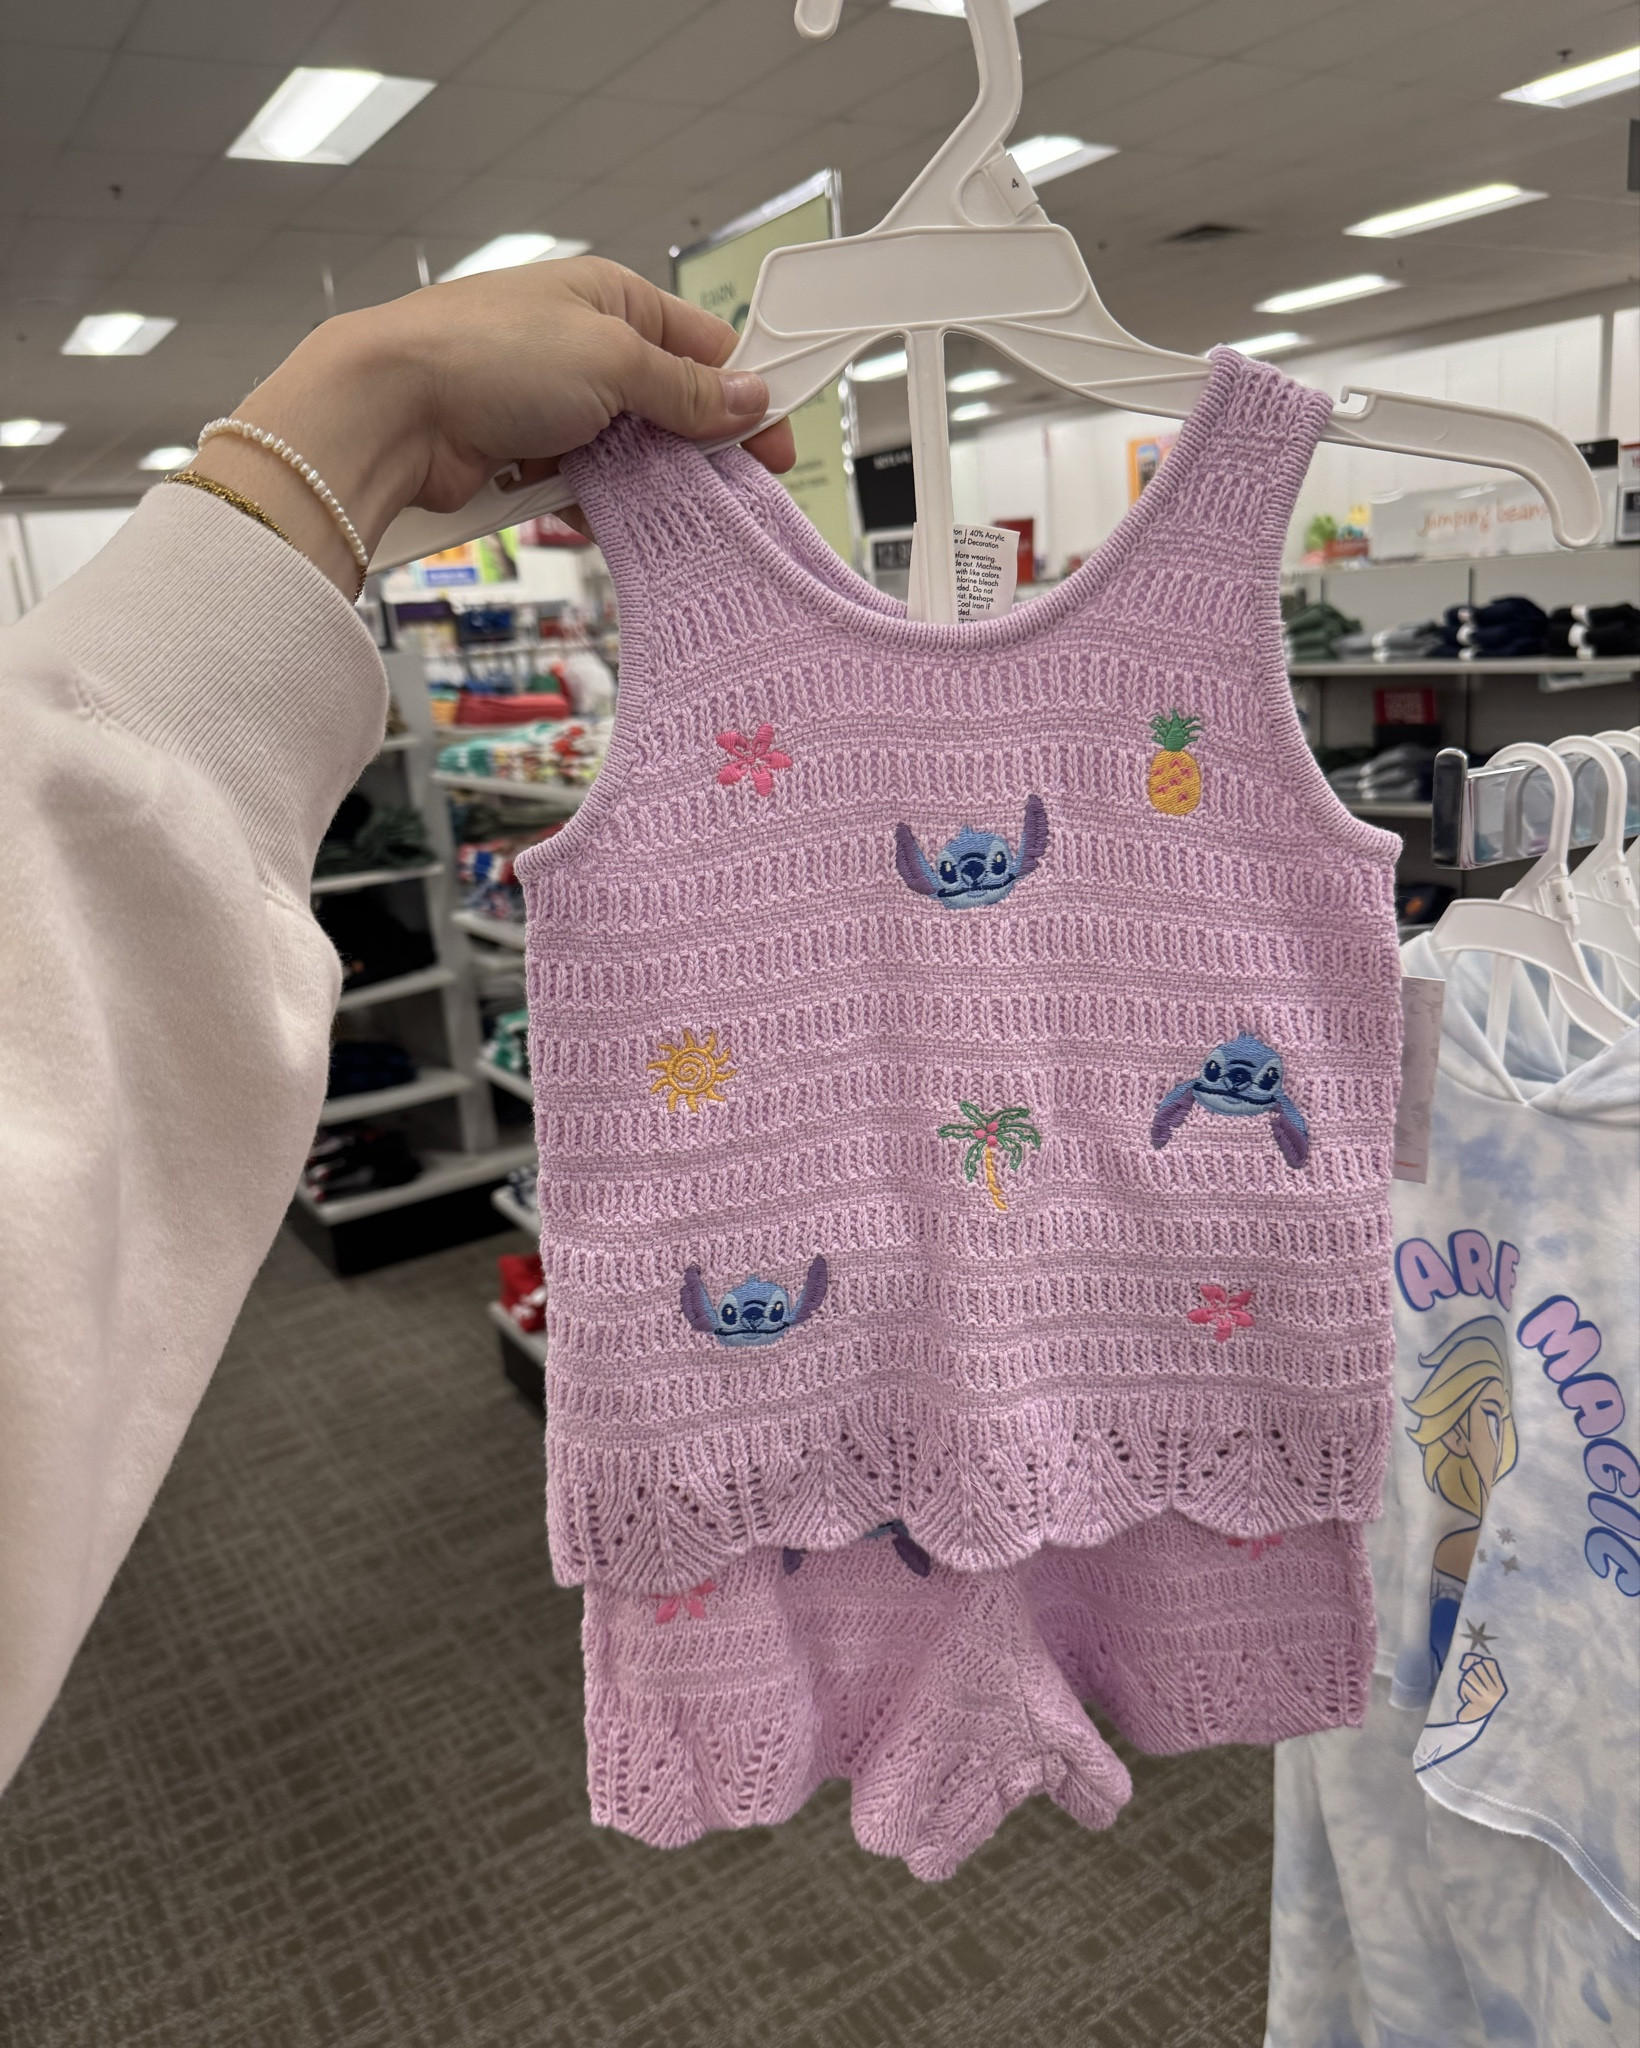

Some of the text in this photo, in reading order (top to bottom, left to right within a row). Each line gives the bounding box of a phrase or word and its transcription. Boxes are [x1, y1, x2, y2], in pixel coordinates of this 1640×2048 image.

[1011, 177, 1020, 189] 4
[969, 530, 983, 538] 40%
[985, 532, 1005, 542] Acrylic
[960, 537, 967, 545] of
[967, 538, 999, 549] Decoration
[976, 561, 1002, 571] Machine
[957, 575, 998, 587] hlorine bleach
[973, 585, 982, 593] Do
[986, 602, 991, 610] if
[1517, 1294, 1640, 1597] MAGIC
